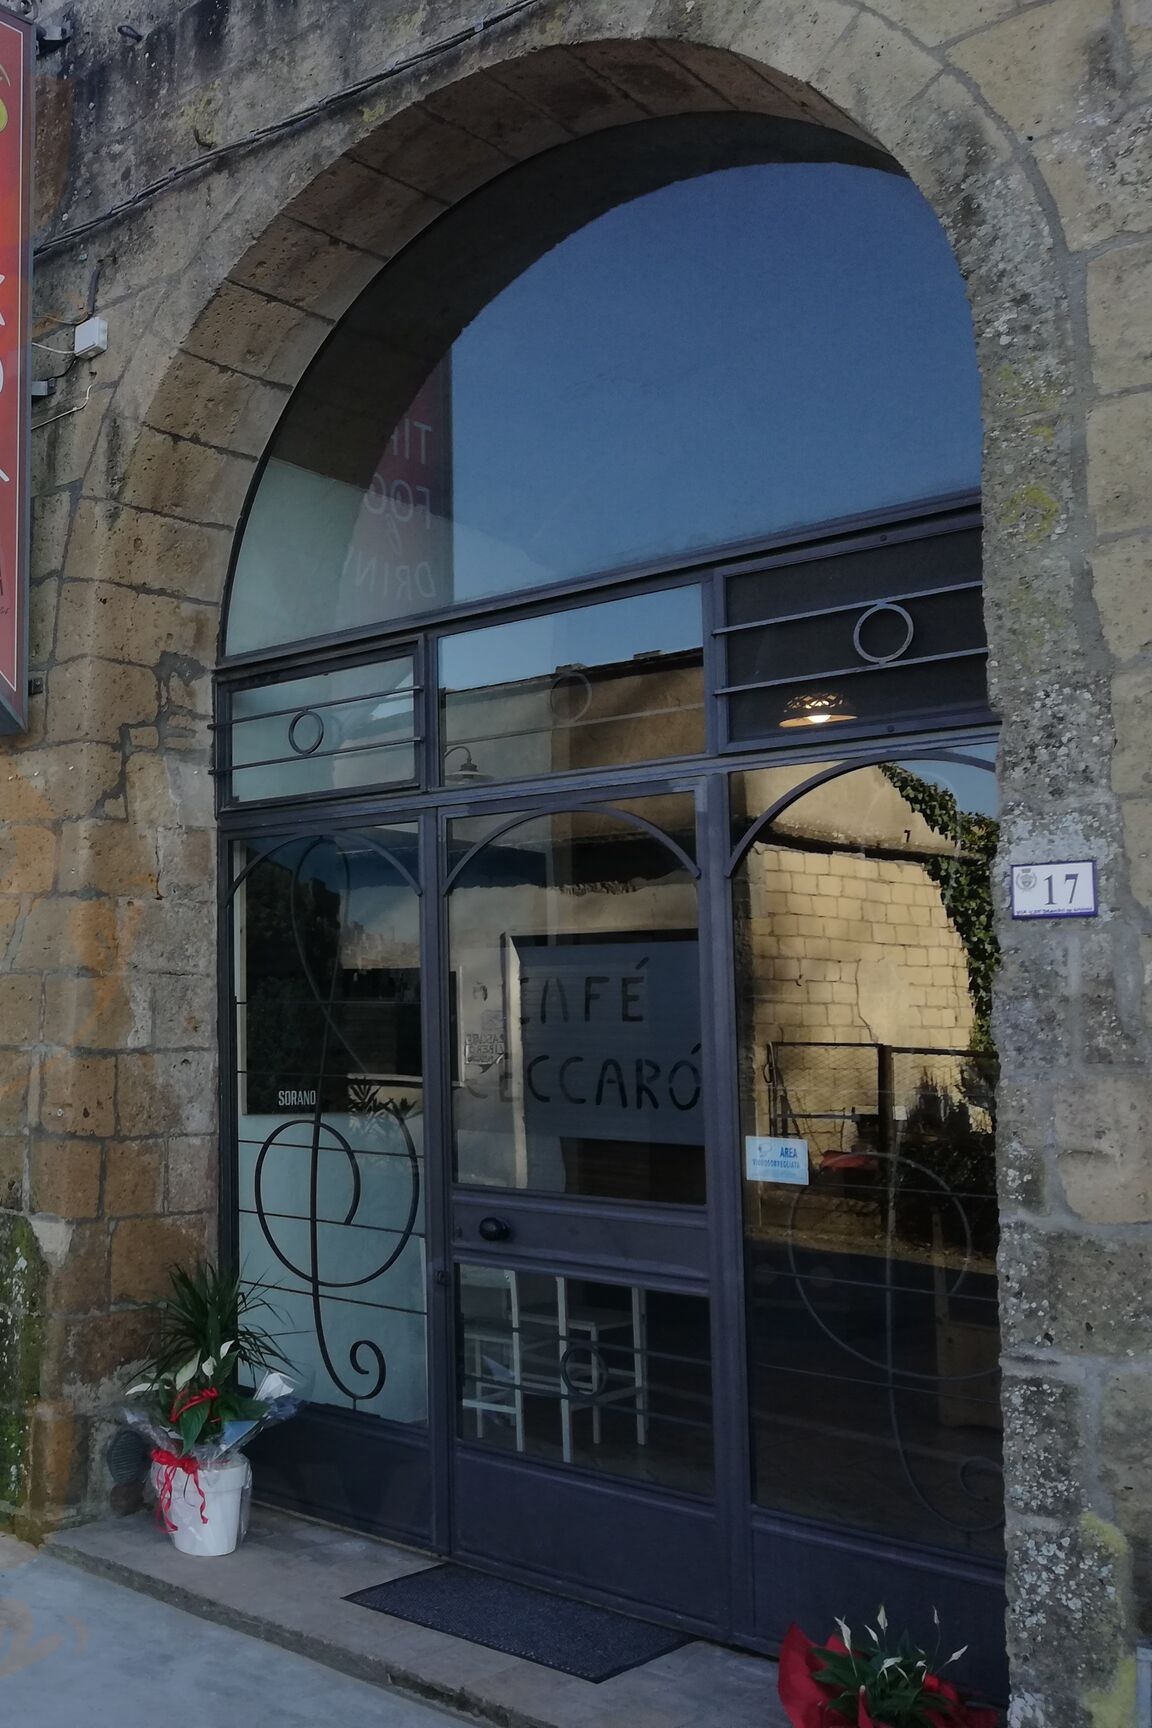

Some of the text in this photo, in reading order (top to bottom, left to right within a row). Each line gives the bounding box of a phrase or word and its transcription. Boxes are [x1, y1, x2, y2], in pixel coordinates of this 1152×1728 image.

[1043, 873, 1079, 906] 17
[278, 1090, 316, 1106] SORANO
[780, 1147, 797, 1158] AREA
